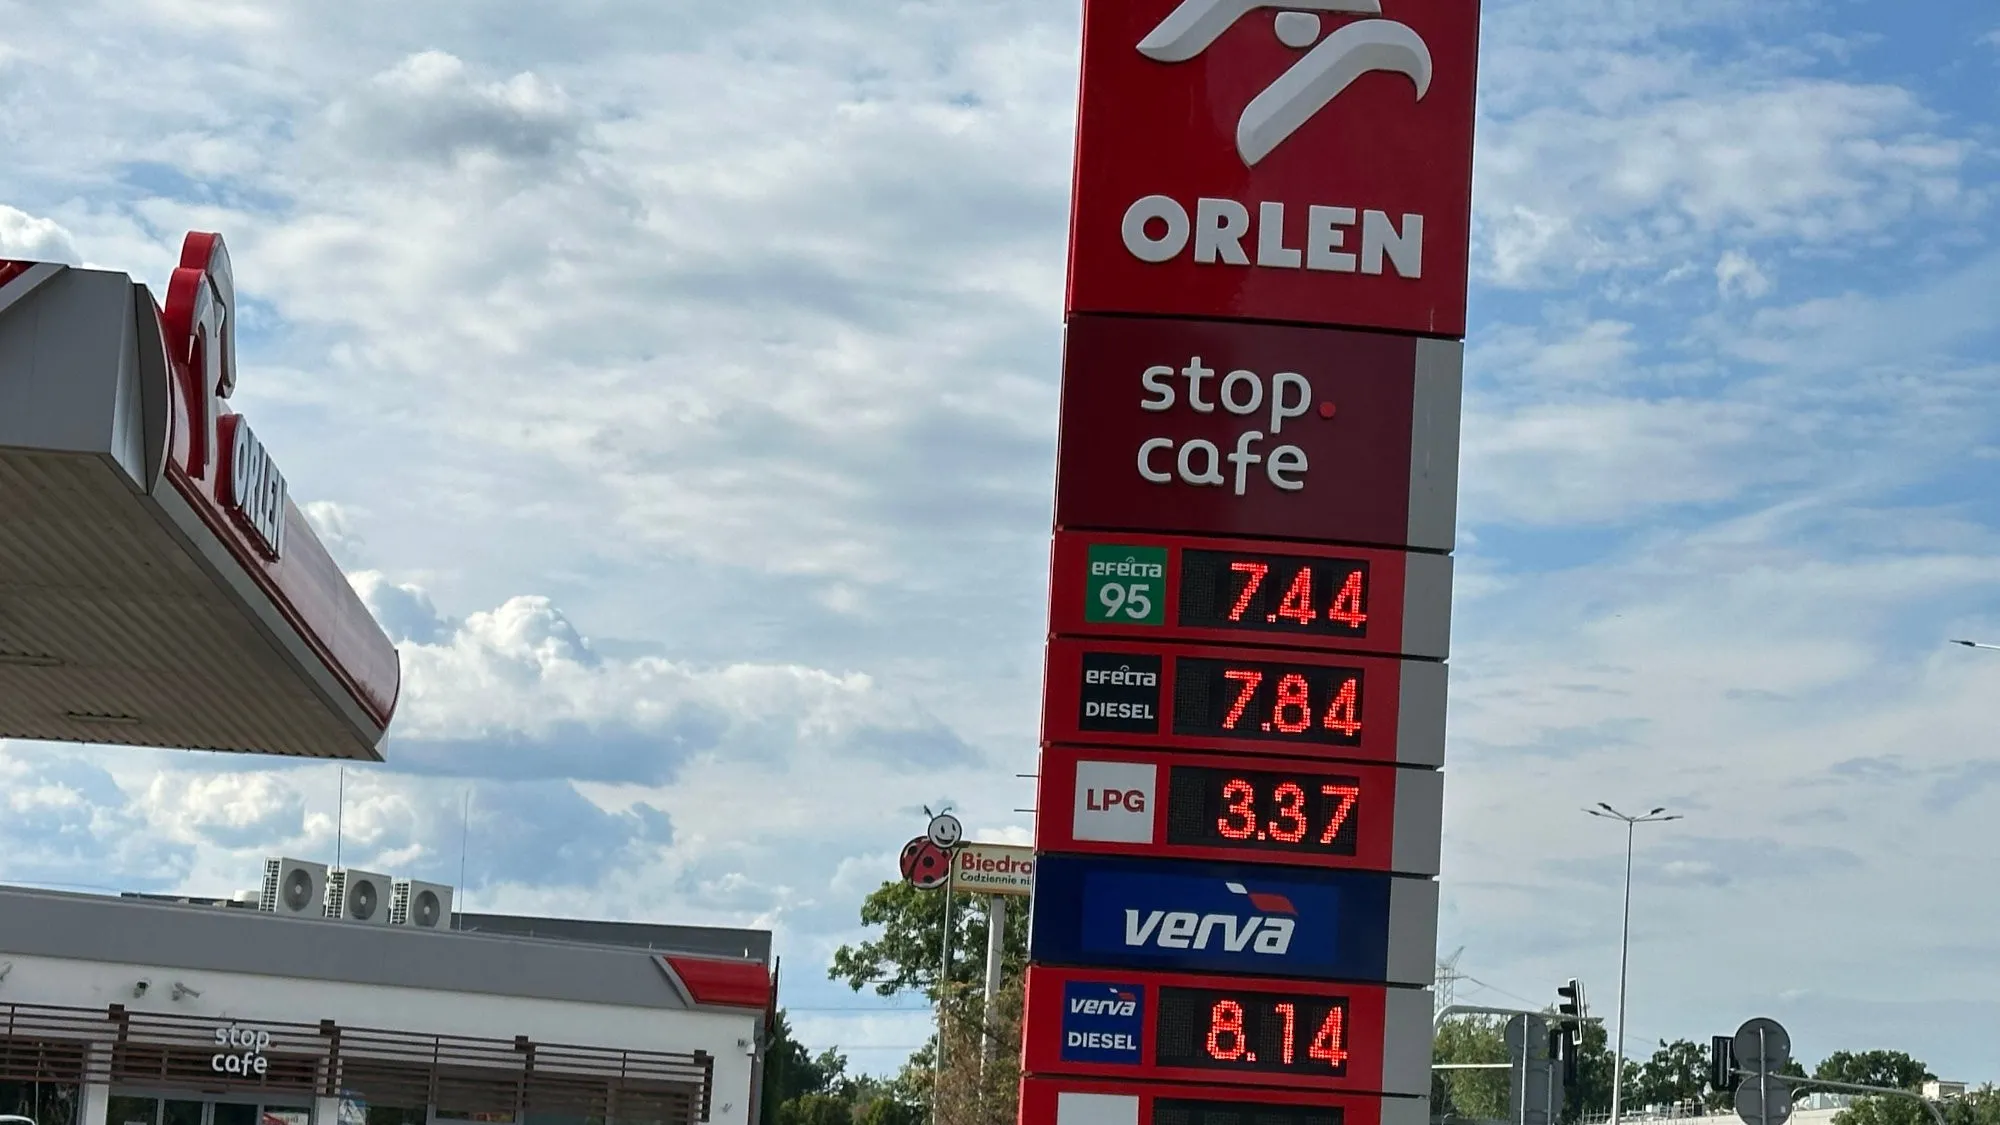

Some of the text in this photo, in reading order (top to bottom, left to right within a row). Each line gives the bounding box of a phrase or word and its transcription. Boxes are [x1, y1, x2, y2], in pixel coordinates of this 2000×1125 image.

[1121, 194, 1424, 279] ORLEN
[1137, 430, 1309, 496] cafe
[231, 413, 288, 561] ORLEN
[1099, 582, 1151, 619] 95
[1228, 561, 1367, 628] 7.44
[1085, 701, 1154, 719] DIESEL
[1222, 669, 1362, 736] 7.84
[1086, 788, 1145, 813] LPG
[1218, 778, 1360, 845] 3.37
[960, 871, 1017, 885] Codziennie
[1124, 908, 1296, 955] verva
[1070, 997, 1136, 1017] verva
[1067, 1031, 1137, 1051] DIESEL
[1206, 1000, 1348, 1067] 8.14
[211, 1052, 268, 1077] cafe
